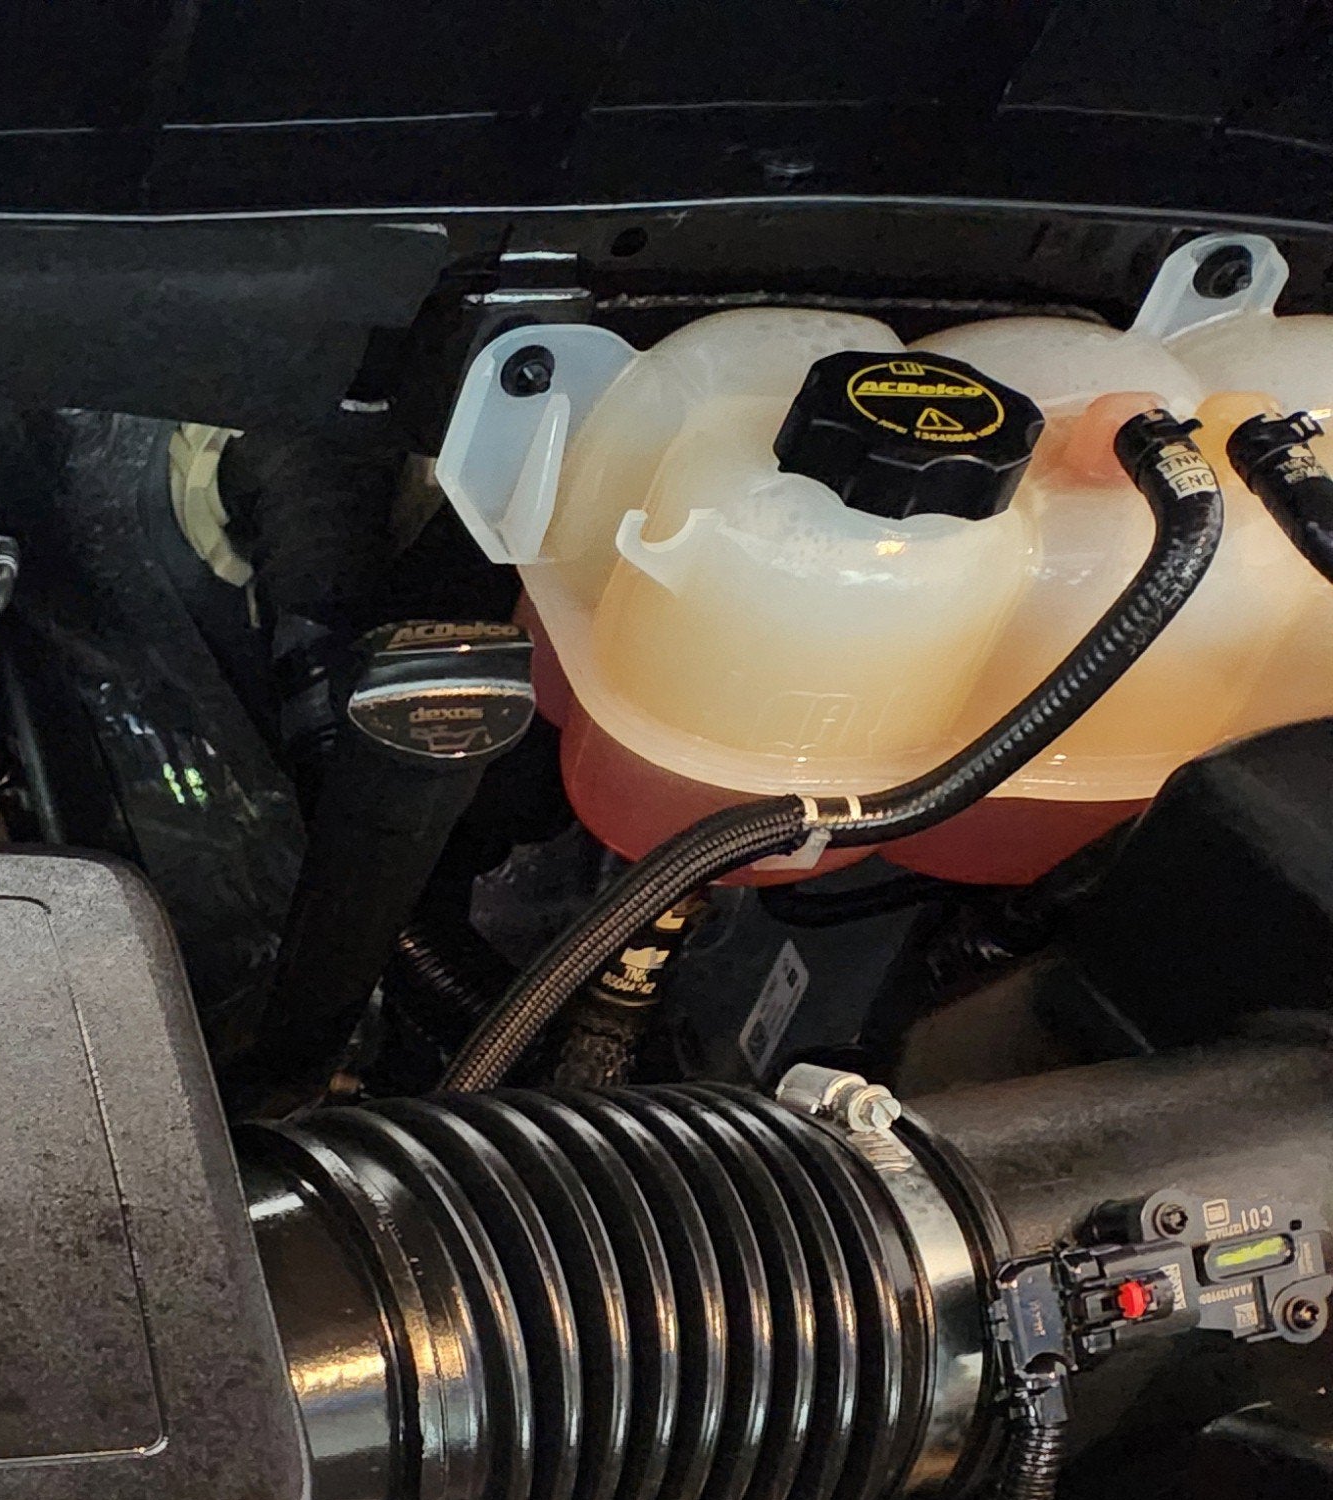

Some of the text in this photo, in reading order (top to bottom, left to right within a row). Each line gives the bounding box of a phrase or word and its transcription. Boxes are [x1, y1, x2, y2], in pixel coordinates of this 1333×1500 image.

[856, 380, 984, 397] ACDelco
[392, 621, 520, 644] ACDelco
[409, 706, 484, 723] dexos
